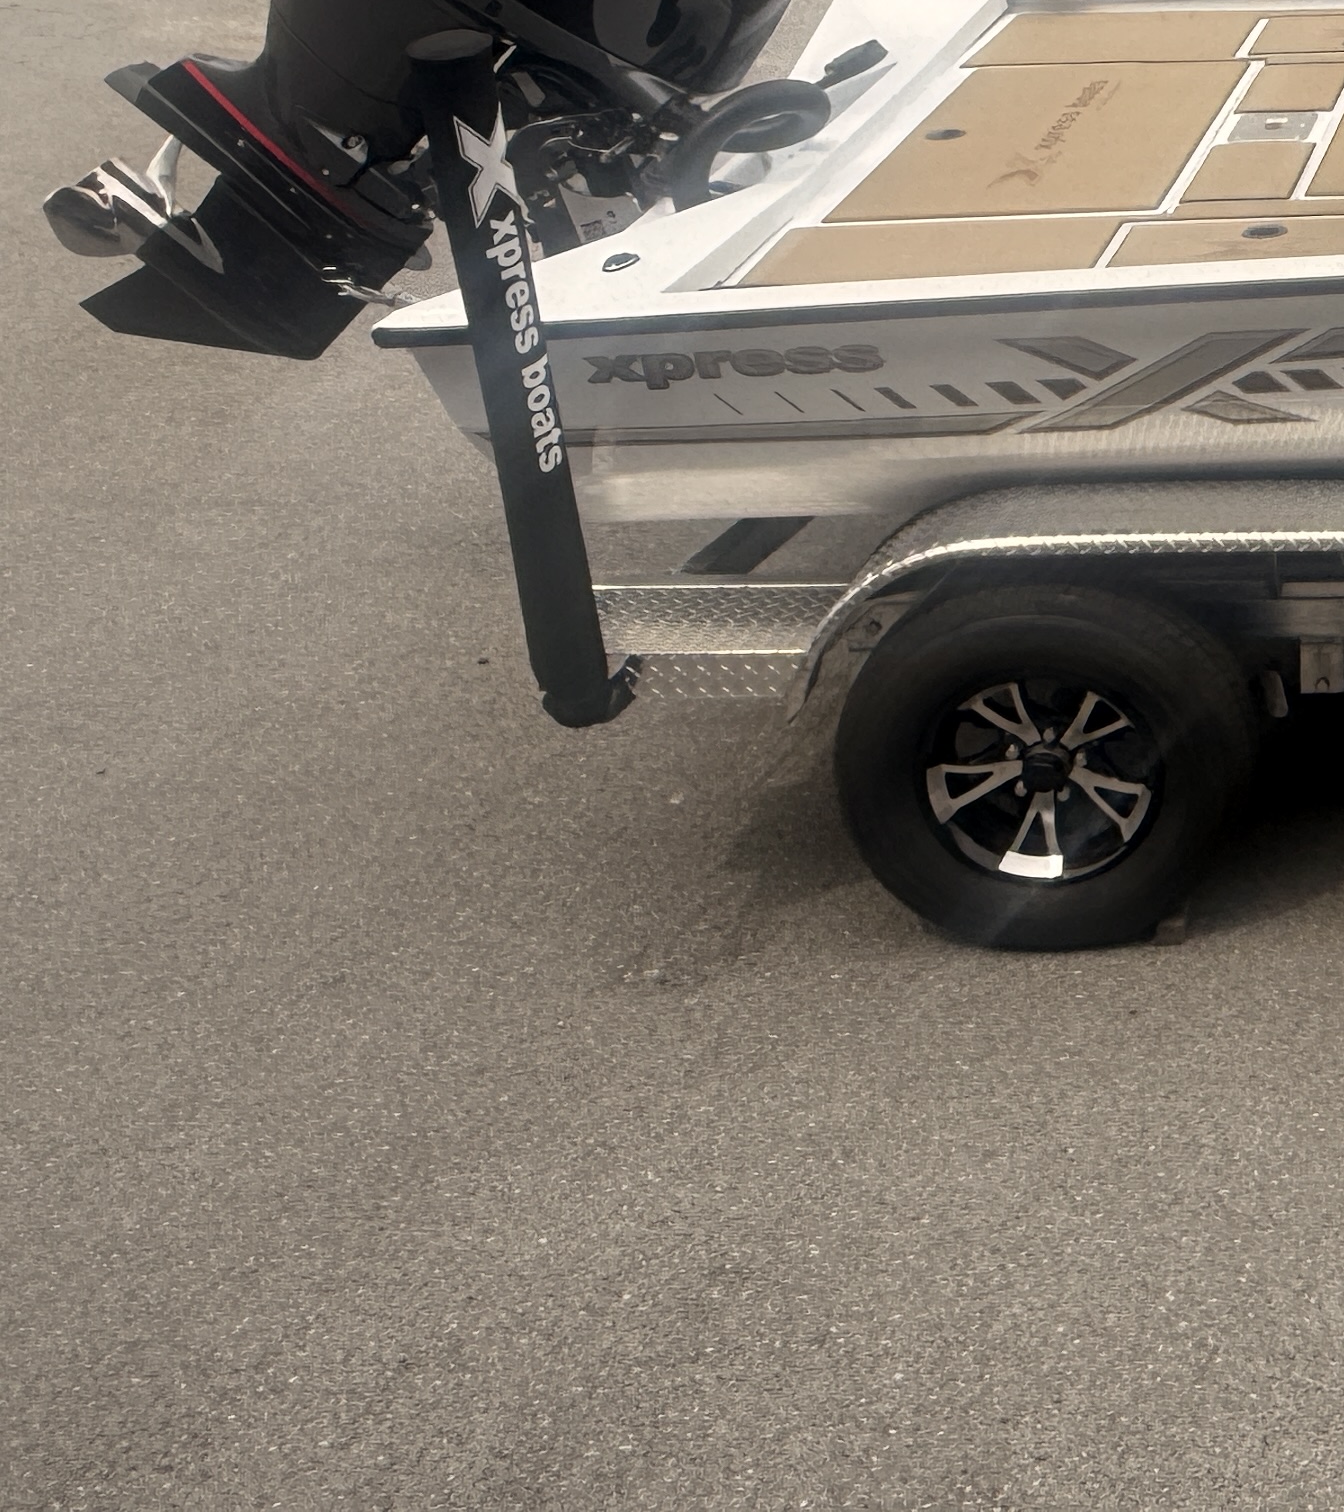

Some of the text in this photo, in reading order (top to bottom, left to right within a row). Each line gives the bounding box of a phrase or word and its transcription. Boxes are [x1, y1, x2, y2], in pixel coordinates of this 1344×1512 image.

[485, 209, 564, 475] xpress boats
[582, 344, 886, 391] xpress
